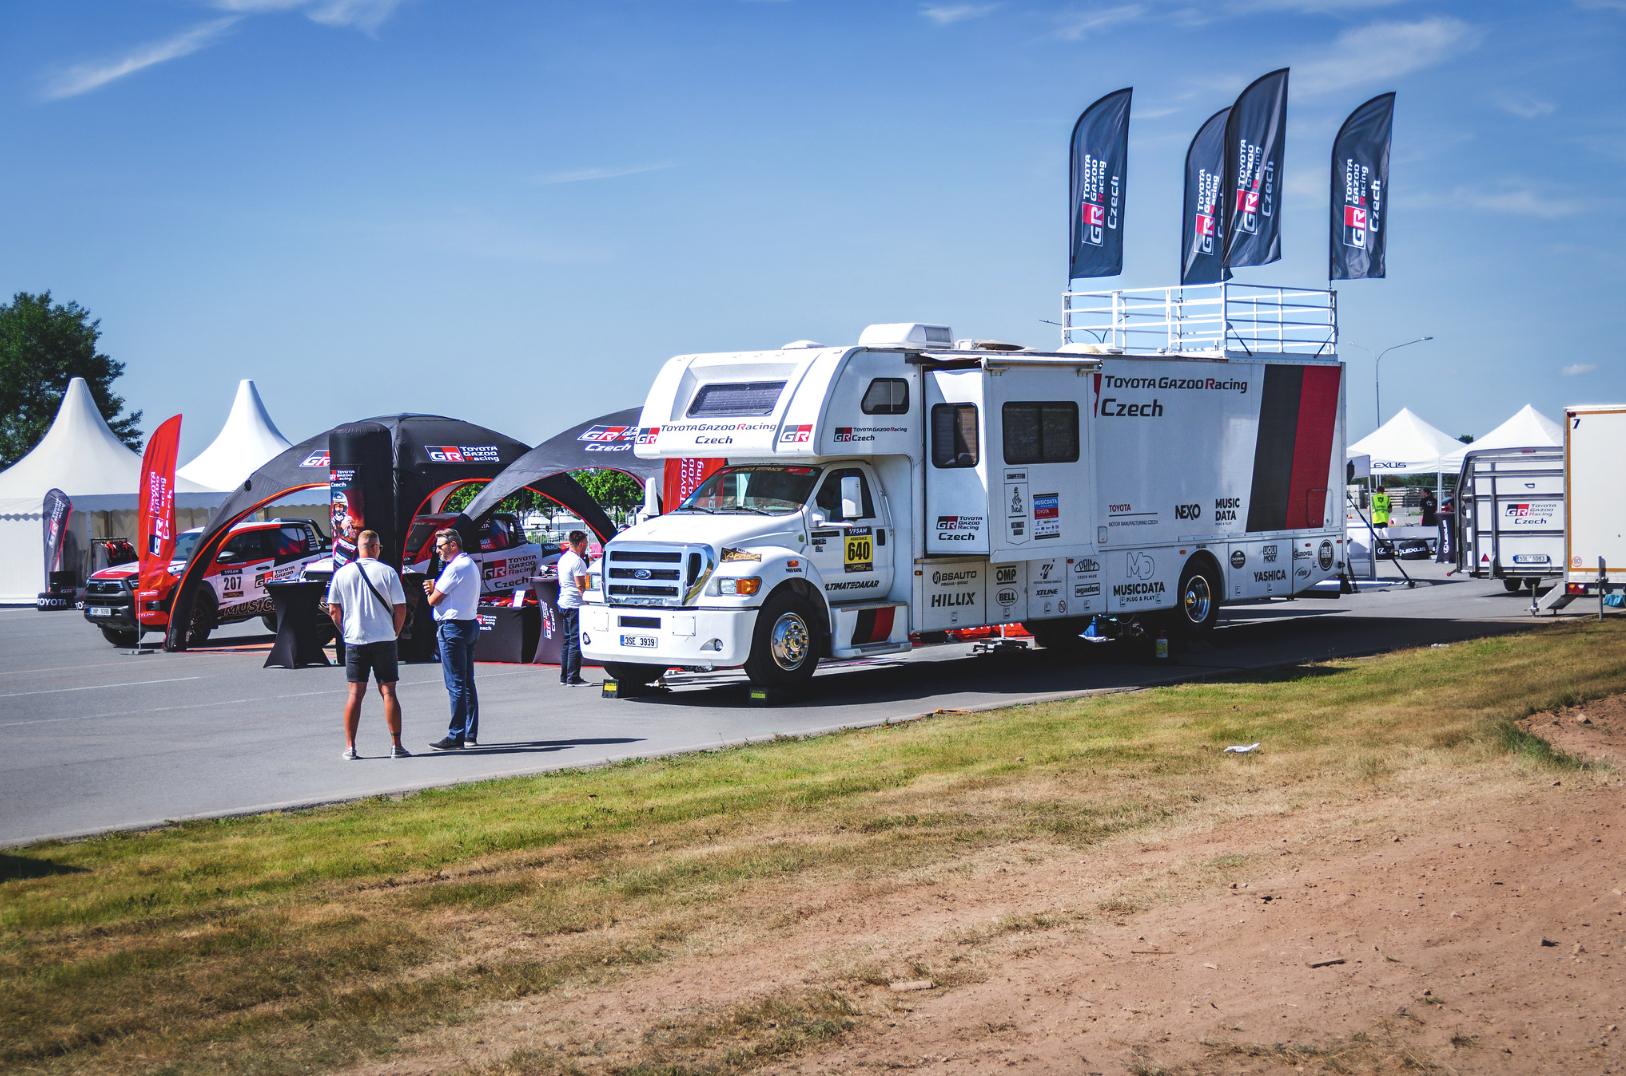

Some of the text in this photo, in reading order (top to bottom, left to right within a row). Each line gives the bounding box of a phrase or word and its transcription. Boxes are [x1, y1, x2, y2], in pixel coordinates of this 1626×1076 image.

[1238, 139, 1247, 187] TOYOTA
[1246, 144, 1254, 188] GAZOO
[1252, 146, 1263, 190] Racing
[1083, 154, 1091, 200] TOYOTA
[1090, 159, 1098, 202] GAZOO
[1098, 161, 1107, 202] Racing
[1197, 169, 1206, 212] TOYOTA
[1262, 161, 1274, 217] Czech
[1359, 166, 1369, 206] Racing
[1204, 174, 1212, 214] GAZOO
[1210, 175, 1220, 214] Racing
[1108, 176, 1120, 230] Czech
[1370, 180, 1380, 232] Czech
[1105, 375, 1248, 394] TOYOTA GAZOO Racing
[1100, 398, 1163, 417] Czech
[661, 424, 697, 432] TOYOTA
[736, 423, 777, 432] Racing
[1573, 419, 1581, 429] 7
[695, 436, 733, 444] Czech
[585, 443, 632, 451] Czech
[1109, 504, 1131, 512] TOYOTA
[1215, 498, 1240, 509] MUSIC
[1175, 504, 1201, 520] NEXO
[1215, 510, 1236, 521] DATA
[848, 541, 870, 561] 640
[1263, 546, 1277, 555] LIQUI
[508, 555, 537, 563] TOYOTA
[509, 561, 535, 569] GAZOO
[274, 566, 295, 575] TOYOTA
[509, 565, 536, 575] Racing
[941, 571, 977, 581] BSAUTO
[996, 569, 1016, 581] OMP
[1254, 569, 1286, 582] YASHICA
[224, 576, 242, 590] 207
[494, 577, 529, 588] Czech
[1113, 582, 1165, 596] MUSICDATA
[1076, 586, 1099, 594] agados
[37, 598, 67, 606] TOYOTA
[999, 593, 1015, 601] BELL
[625, 637, 655, 647] 3SE 3939
